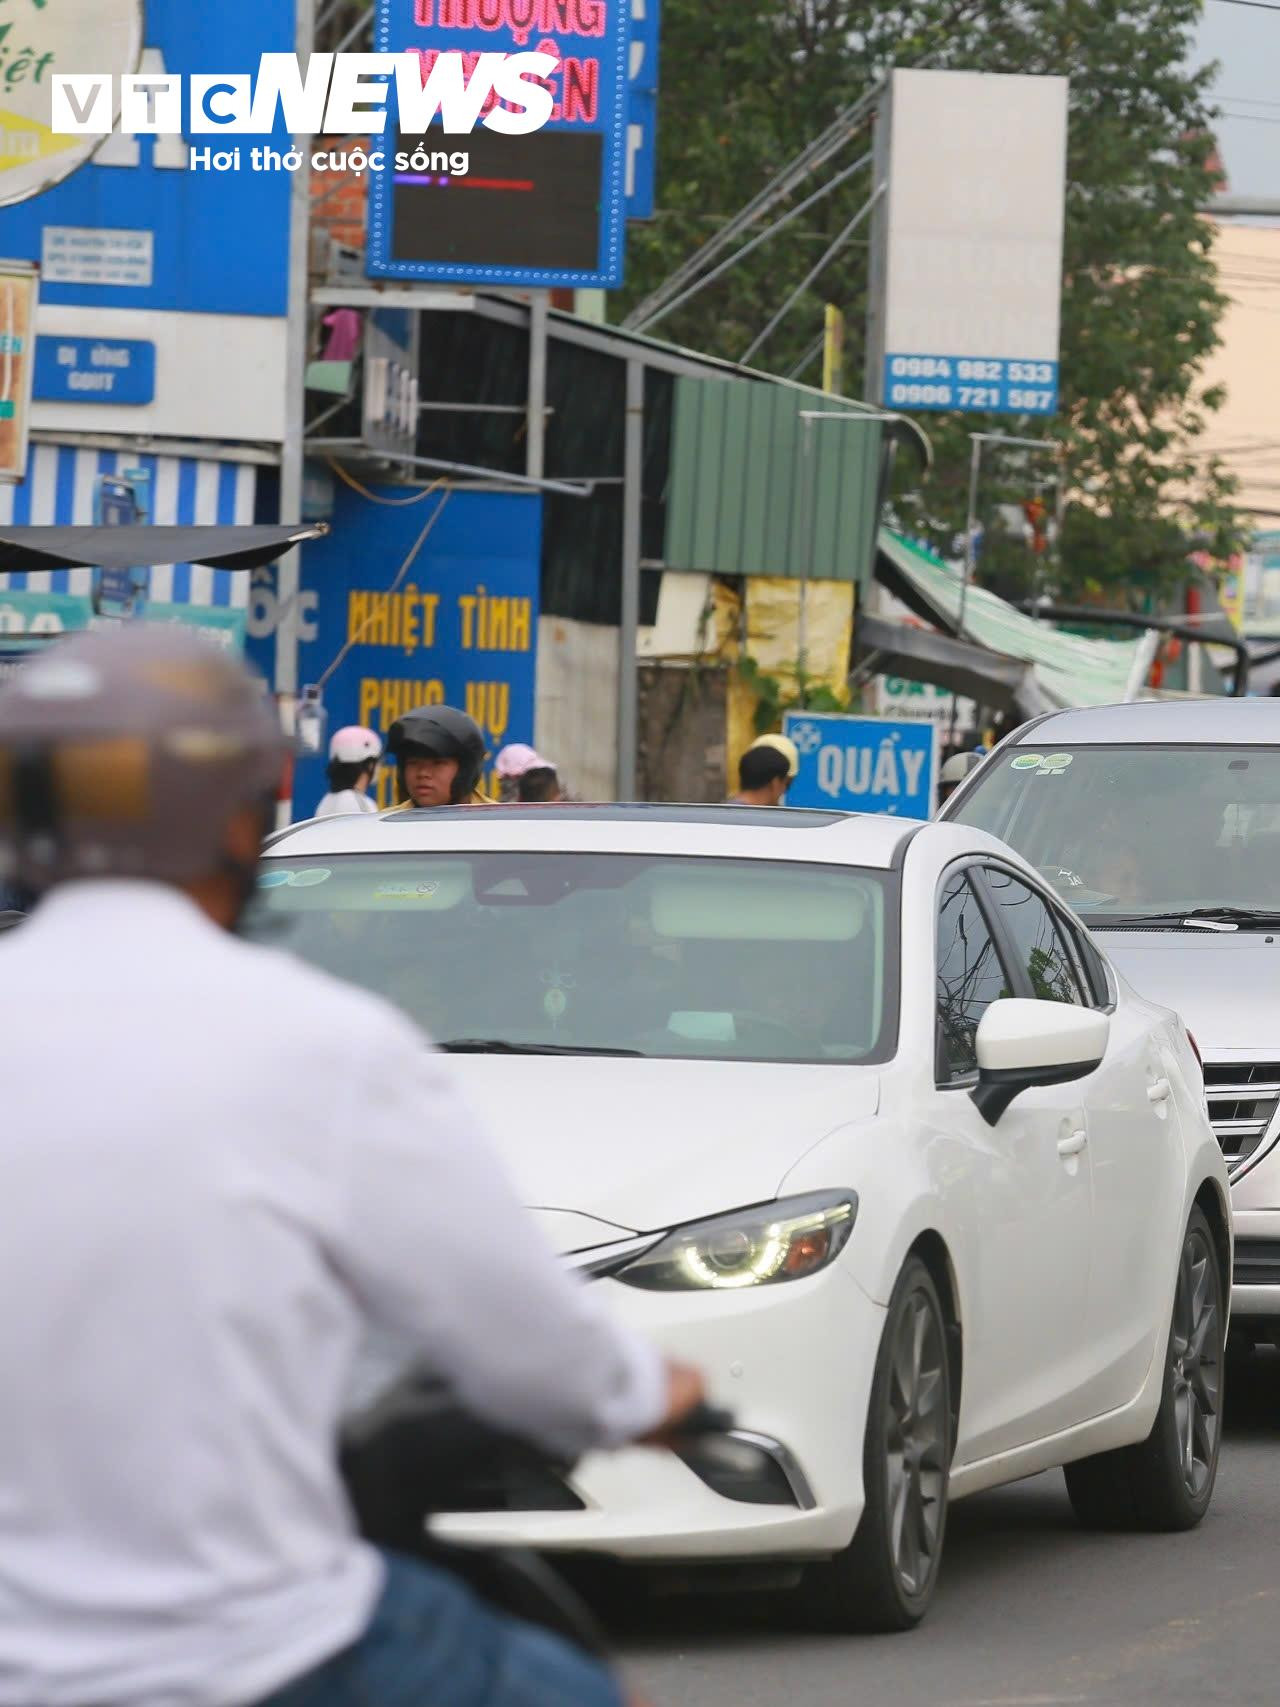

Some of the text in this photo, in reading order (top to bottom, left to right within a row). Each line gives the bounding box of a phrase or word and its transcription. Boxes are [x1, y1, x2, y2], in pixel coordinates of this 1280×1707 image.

[891, 357, 951, 378] 0984
[1007, 362, 1052, 383] 533
[957, 386, 1000, 407] 721
[348, 583, 531, 656] NHIỆT TÌNH
